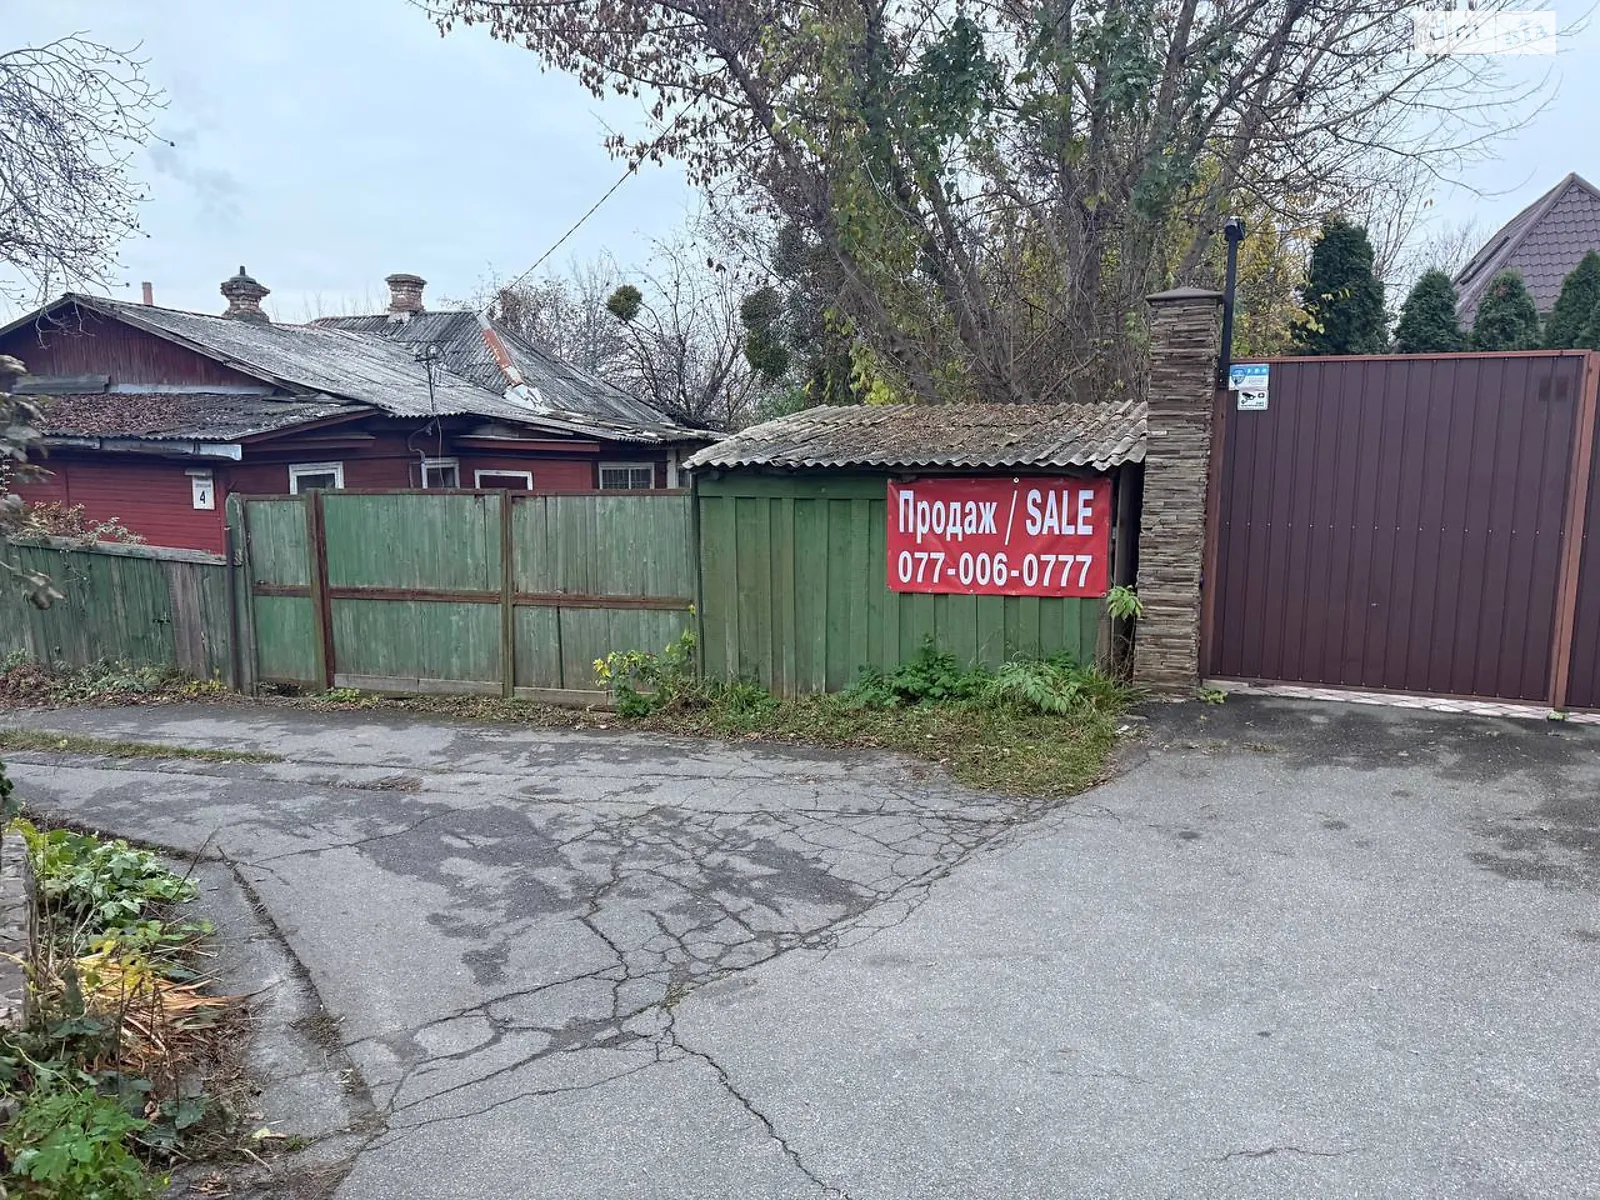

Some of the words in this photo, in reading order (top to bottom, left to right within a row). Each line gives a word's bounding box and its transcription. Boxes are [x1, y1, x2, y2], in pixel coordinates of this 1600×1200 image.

[199, 490, 206, 505] 4
[898, 490, 998, 544] Продаж
[1025, 488, 1095, 536] SALE
[898, 550, 1093, 588] 077-006-0777
